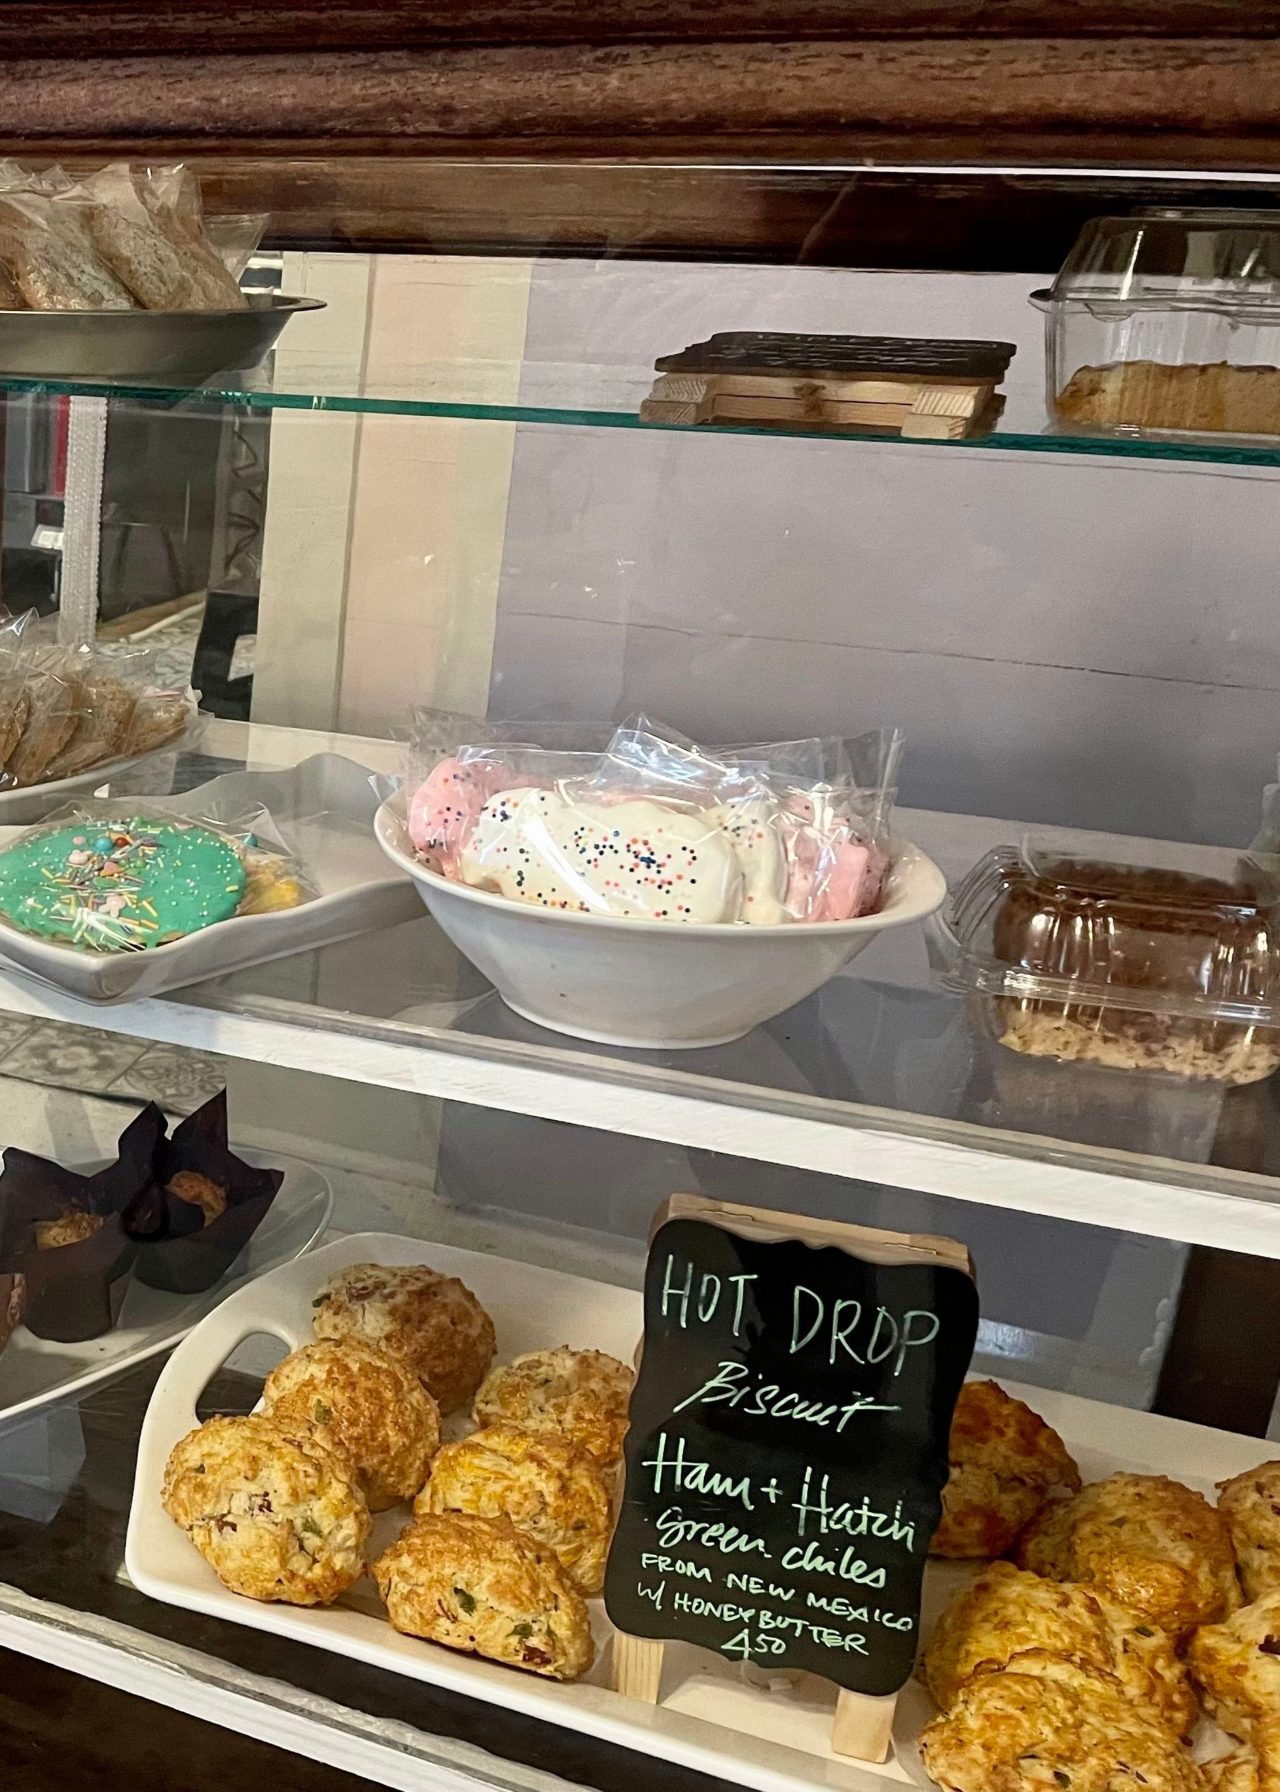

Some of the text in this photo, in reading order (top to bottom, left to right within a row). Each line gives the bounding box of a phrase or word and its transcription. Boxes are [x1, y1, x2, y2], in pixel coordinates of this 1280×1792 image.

[661, 1254, 940, 1376] HOT DROP
[673, 1361, 902, 1433] Biscuit
[641, 1432, 755, 1511] Ham
[641, 1552, 913, 1631] FROM NEW MEXICO
